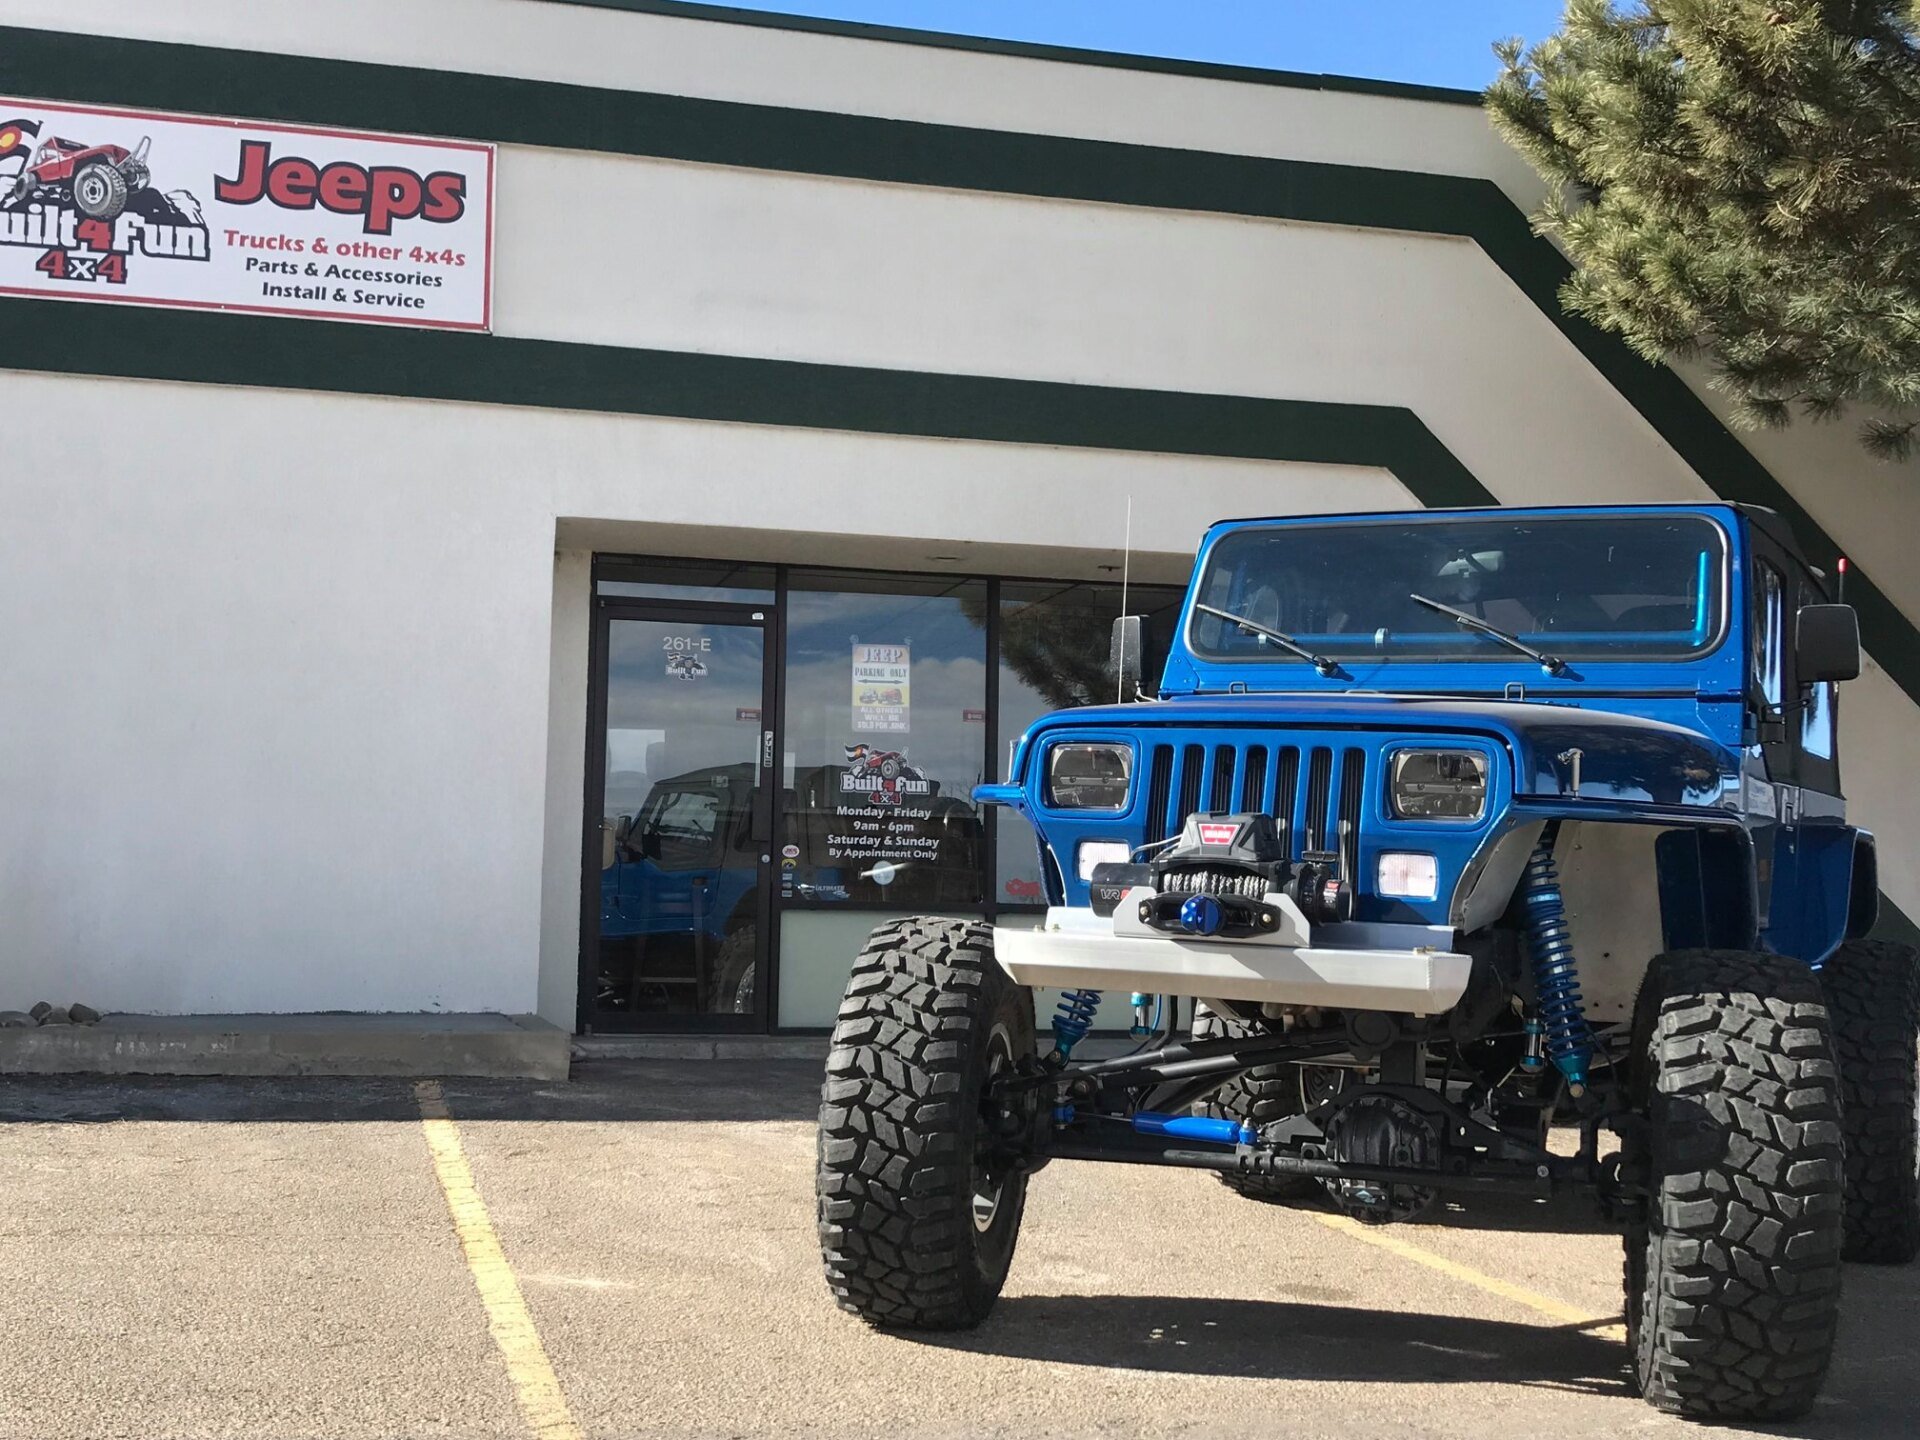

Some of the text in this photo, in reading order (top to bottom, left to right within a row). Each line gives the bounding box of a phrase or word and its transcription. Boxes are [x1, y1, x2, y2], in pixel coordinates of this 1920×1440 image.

[214, 139, 467, 236] Jeeps
[223, 229, 466, 266] Trucks & other 4x4s
[36, 249, 128, 285] 4x4
[245, 257, 443, 287] Parts & Accessories
[262, 281, 425, 309] Install & Service
[663, 636, 711, 651] 261-E
[863, 648, 903, 663] JEEP
[855, 667, 907, 677] PARKING ONLY
[836, 805, 886, 819] Monday
[893, 807, 932, 820] Friday
[853, 820, 879, 831] 9am
[888, 821, 914, 833] 6pm
[827, 834, 940, 849] Saturday & Sunday
[829, 848, 938, 860] By Appointment Only
